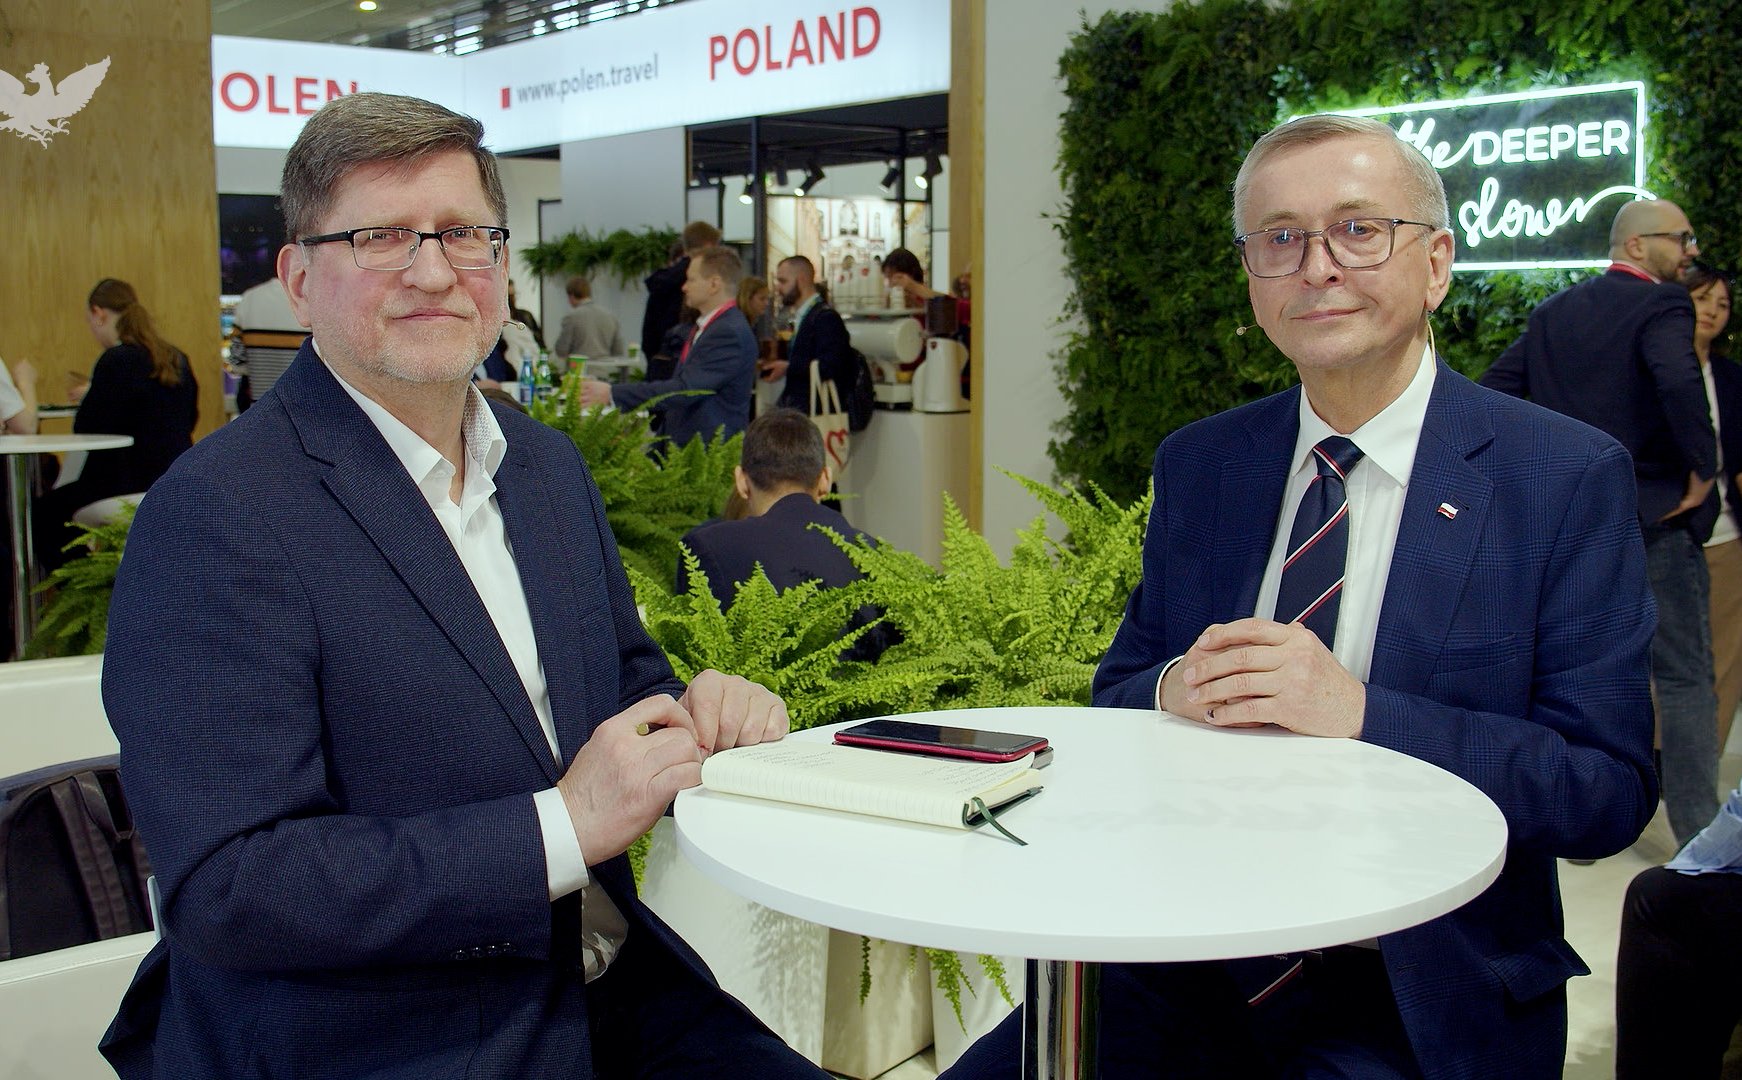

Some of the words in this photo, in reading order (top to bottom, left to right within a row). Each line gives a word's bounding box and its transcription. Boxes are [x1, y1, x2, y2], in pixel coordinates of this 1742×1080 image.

[709, 6, 881, 81] POLAND
[219, 72, 357, 115] OLEN
[517, 53, 659, 103] www.polen.travel
[1472, 120, 1631, 166] DEEPER
[1458, 176, 1657, 248] slower
